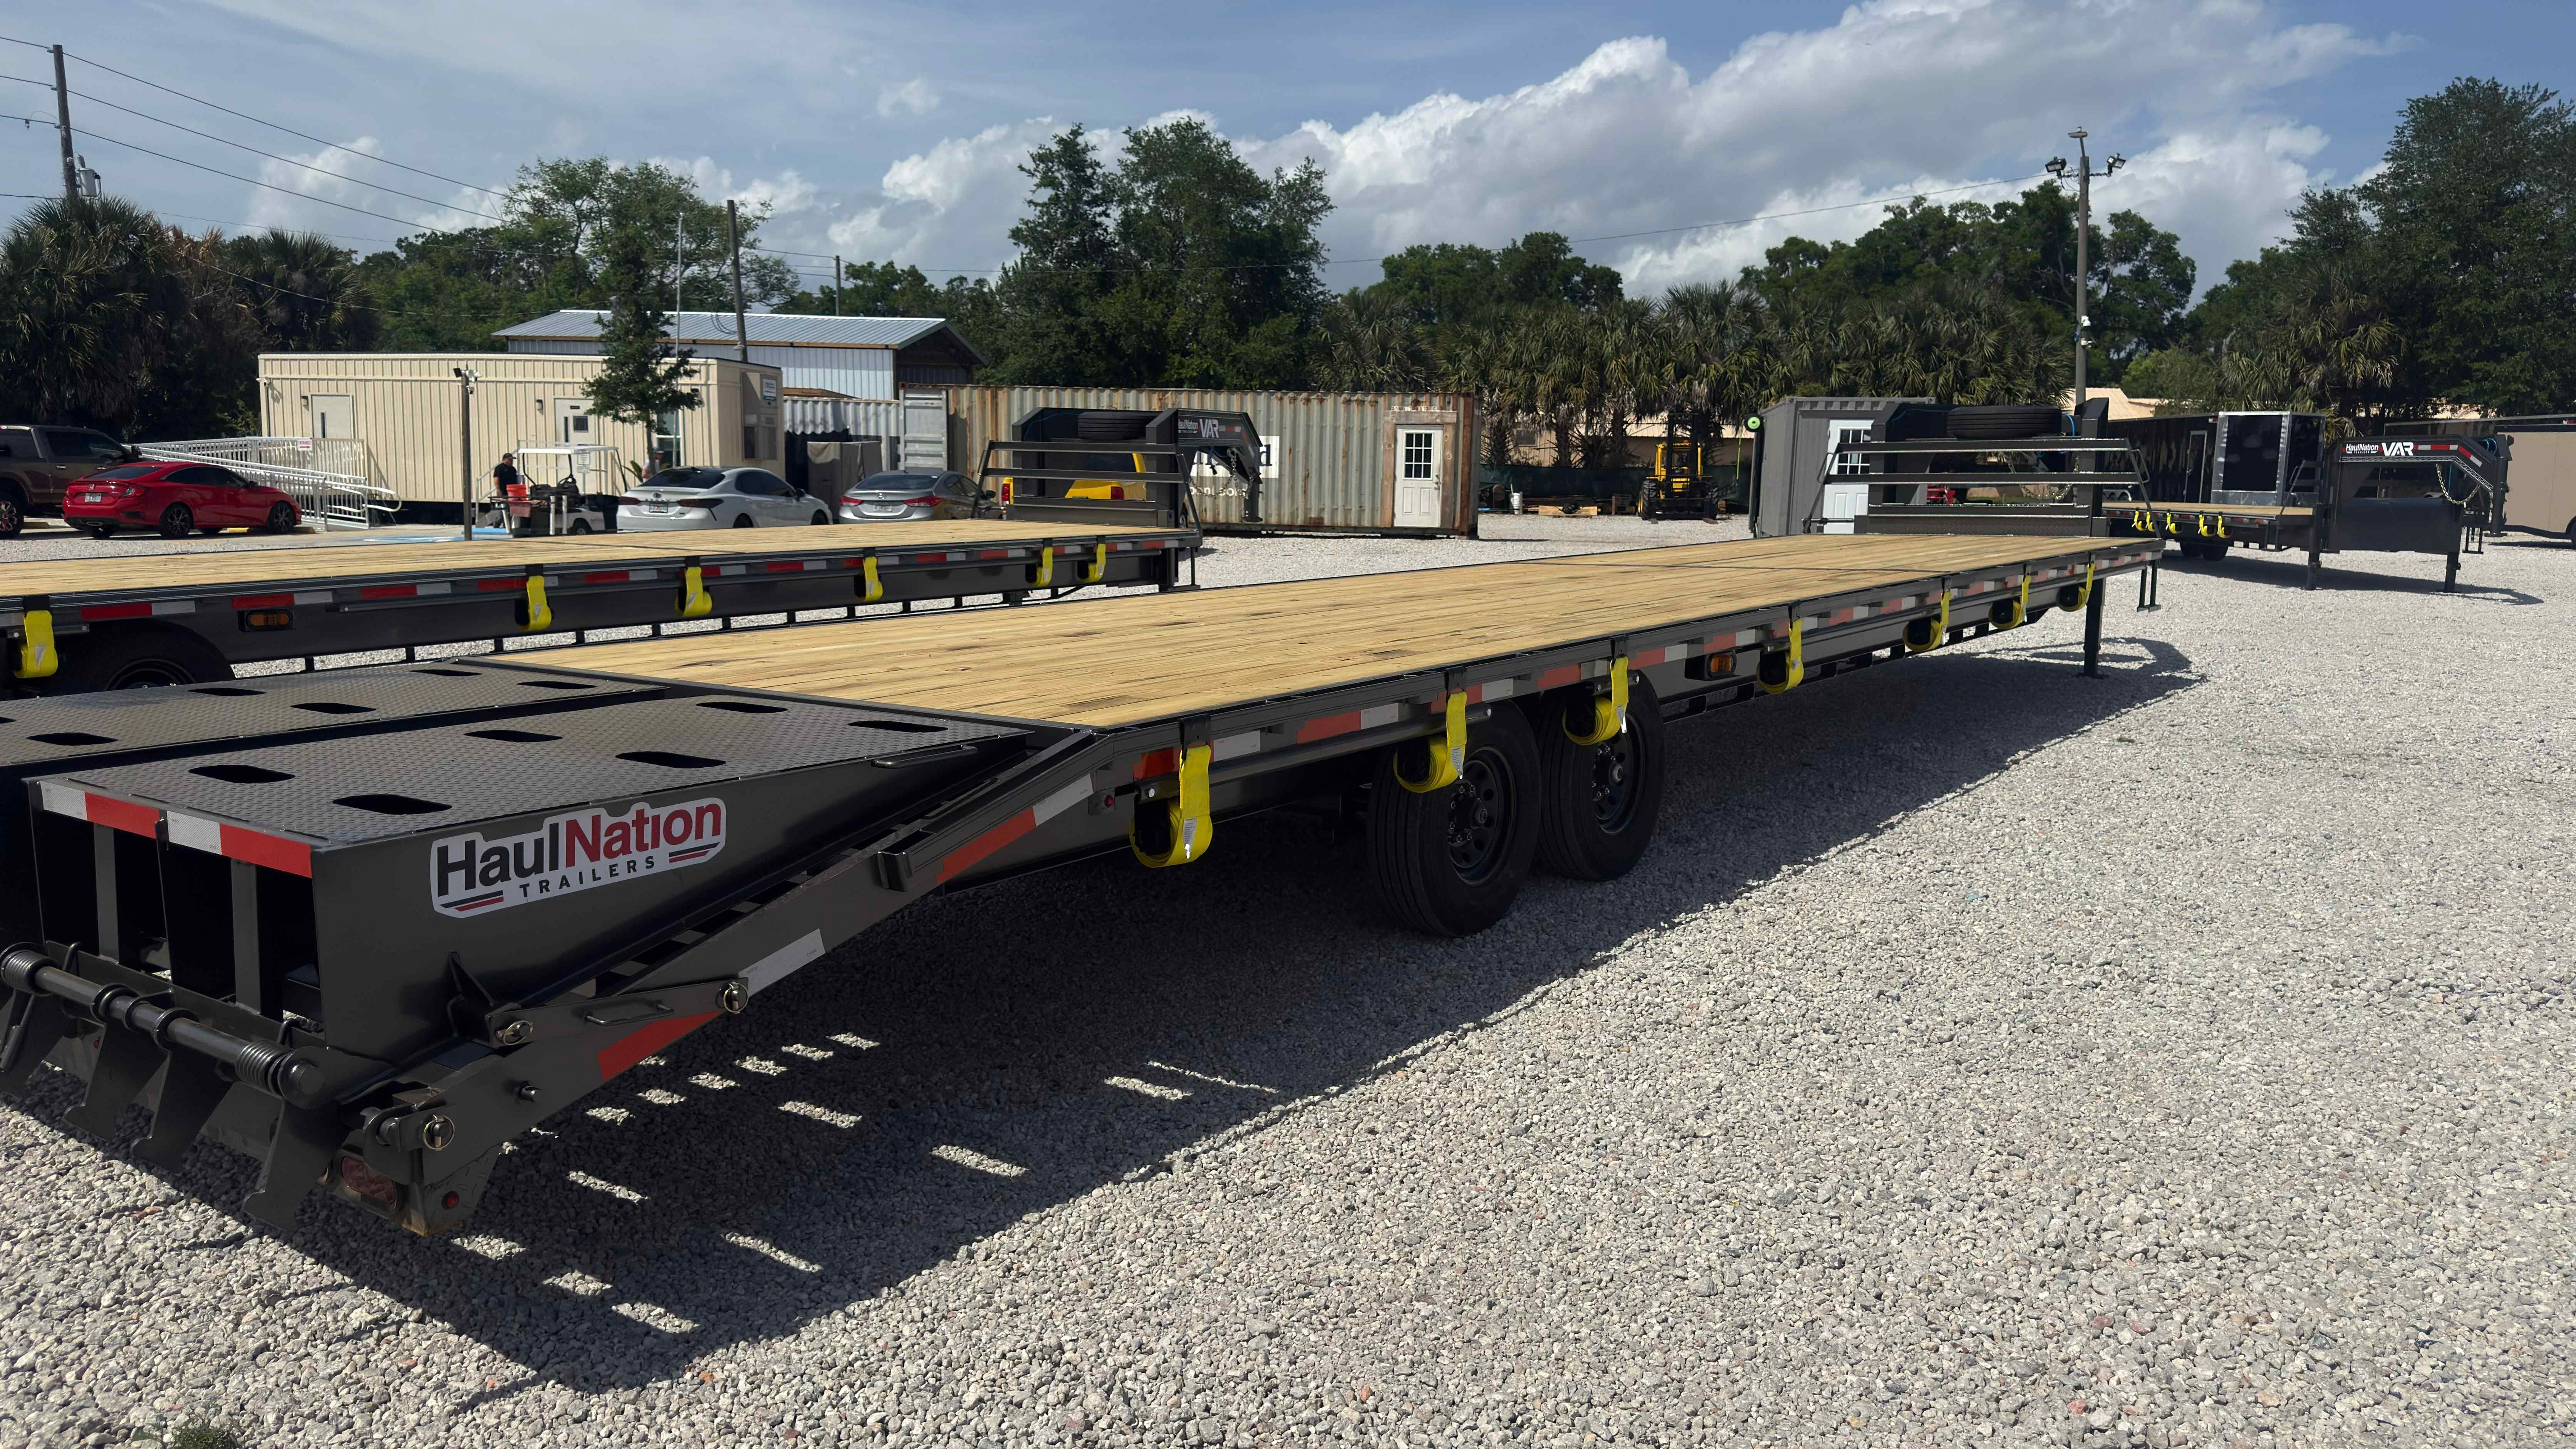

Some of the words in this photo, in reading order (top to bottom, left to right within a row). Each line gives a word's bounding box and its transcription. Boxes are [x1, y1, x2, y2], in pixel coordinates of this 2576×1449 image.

[1178, 419, 1198, 429] aulNation
[1199, 419, 1219, 438] VAR
[2381, 442, 2414, 456] VAR
[437, 803, 721, 897] HaulNation
[519, 855, 655, 898] TRAILERS
